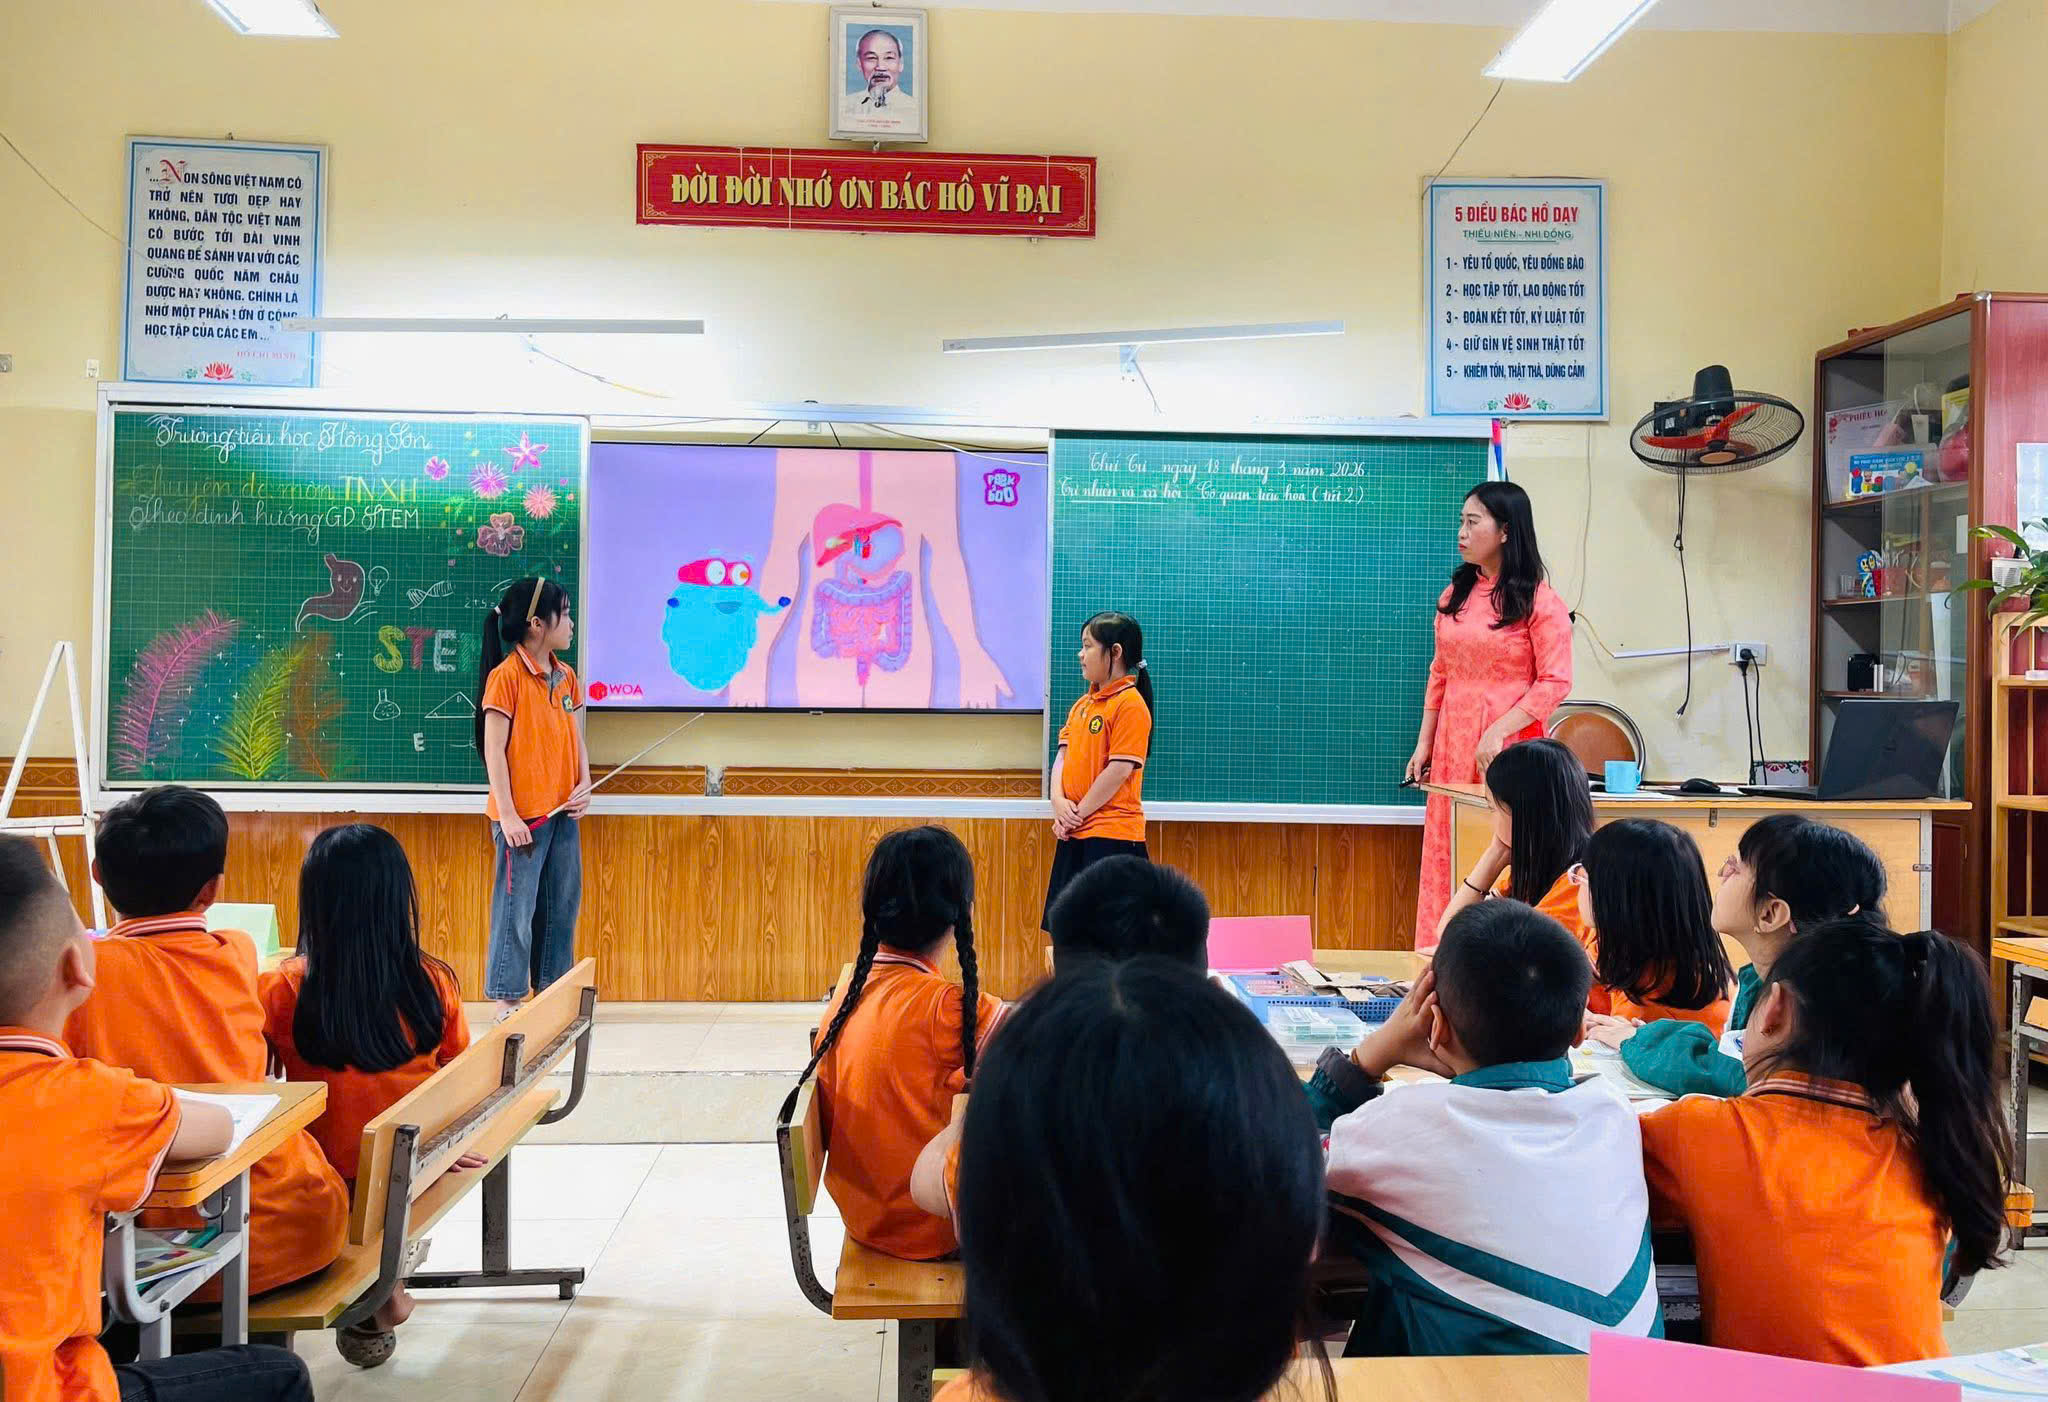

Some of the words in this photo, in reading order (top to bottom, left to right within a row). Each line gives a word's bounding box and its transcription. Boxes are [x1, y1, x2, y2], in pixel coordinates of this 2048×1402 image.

[202, 172, 231, 185] SÔNG
[234, 175, 257, 189] VIỆT
[259, 176, 284, 188] NAM
[287, 176, 302, 189] CÓ
[150, 186, 171, 201] TRỞ
[181, 190, 203, 202] NÊN
[214, 192, 238, 204] TƯƠI
[248, 195, 269, 208] ĐẸP
[280, 197, 301, 208] HAY
[671, 163, 718, 204] ĐỜI
[725, 165, 772, 206] ĐỜI
[779, 169, 832, 208] NHỚ
[839, 179, 874, 210] ƠN
[880, 172, 932, 211] BÁC
[937, 168, 975, 212] HỒ
[983, 176, 1008, 212] VĨ
[1016, 184, 1062, 223] ĐẠI
[195, 210, 217, 222] DÂN
[222, 211, 242, 225] TỘC
[248, 212, 270, 227] VIỆT
[275, 215, 300, 227] NAM
[1455, 206, 1462, 222] 5
[1467, 201, 1496, 222] ĐIỀU
[1502, 203, 1527, 222] BÁC
[1532, 201, 1549, 222] HỒ
[1553, 206, 1579, 225] DẠY
[148, 227, 163, 239] CÓ
[174, 227, 204, 241] BƯỚC
[215, 228, 233, 242] TỚI
[244, 231, 262, 244] ĐÀI
[273, 234, 300, 246] VINH
[1494, 228, 1516, 238] NIÊN
[1525, 230, 1541, 238] NHI
[1544, 228, 1571, 238] ĐỒNG
[148, 247, 184, 260] QUANG
[188, 246, 201, 260] ĐỂ
[205, 249, 234, 261] SÁNH
[237, 252, 254, 263] VAI
[258, 249, 274, 264] VỚI
[278, 252, 299, 265] CÁC
[1447, 257, 1450, 269] 1
[1463, 254, 1478, 269] YÊU
[1482, 252, 1492, 269] TỔ
[1522, 255, 1538, 269] YÊU
[1567, 255, 1584, 269] BÀO
[195, 266, 224, 281] QUỐC
[234, 269, 259, 282] NĂM
[270, 271, 299, 284] CHÂU
[146, 286, 175, 300] ĐƯỢC
[248, 290, 282, 302] CHÍNH
[286, 291, 298, 303] LÀ
[1446, 284, 1451, 296] 2
[1463, 284, 1480, 299] HỌC
[1483, 281, 1500, 299] TẬP
[1503, 279, 1520, 298] TỐT,
[1523, 284, 1539, 296] LAO
[1543, 281, 1566, 299] ĐỘNG
[1569, 279, 1584, 296] TỐT
[146, 303, 169, 317] NHỜ
[172, 305, 195, 320] MỘT
[258, 306, 265, 321] Ở
[1447, 311, 1451, 323] 3
[1463, 308, 1488, 323] ĐOÀN
[1491, 306, 1507, 323] KẾT
[1510, 306, 1528, 324] TỐT,
[1531, 305, 1542, 323] KỶ
[1545, 308, 1566, 326] LUẬT
[1569, 306, 1584, 323] TỐT
[145, 324, 167, 338] HỌC
[169, 324, 190, 339] TẬP
[193, 322, 214, 337] CỦA
[217, 326, 238, 339] CÁC
[241, 328, 258, 340] EM
[1447, 338, 1451, 350] 4
[1463, 334, 1481, 350] GIỮ
[1482, 335, 1498, 350] GÌN
[1502, 336, 1513, 354] VỆ
[1516, 338, 1539, 350] SINH
[1542, 335, 1565, 353] THẬT
[1568, 333, 1584, 350] TỐT
[1447, 365, 1451, 378] 5
[1464, 363, 1487, 378] KHIÊM
[1508, 363, 1526, 380] THẬT
[1568, 359, 1584, 378] CẢM
[280, 420, 312, 451] học
[1206, 458, 1219, 473] 18
[1278, 460, 1286, 475] 3
[1293, 463, 1324, 476] năm
[1330, 462, 1365, 477] 2026
[326, 506, 356, 527] GD
[609, 684, 643, 695] WOA
